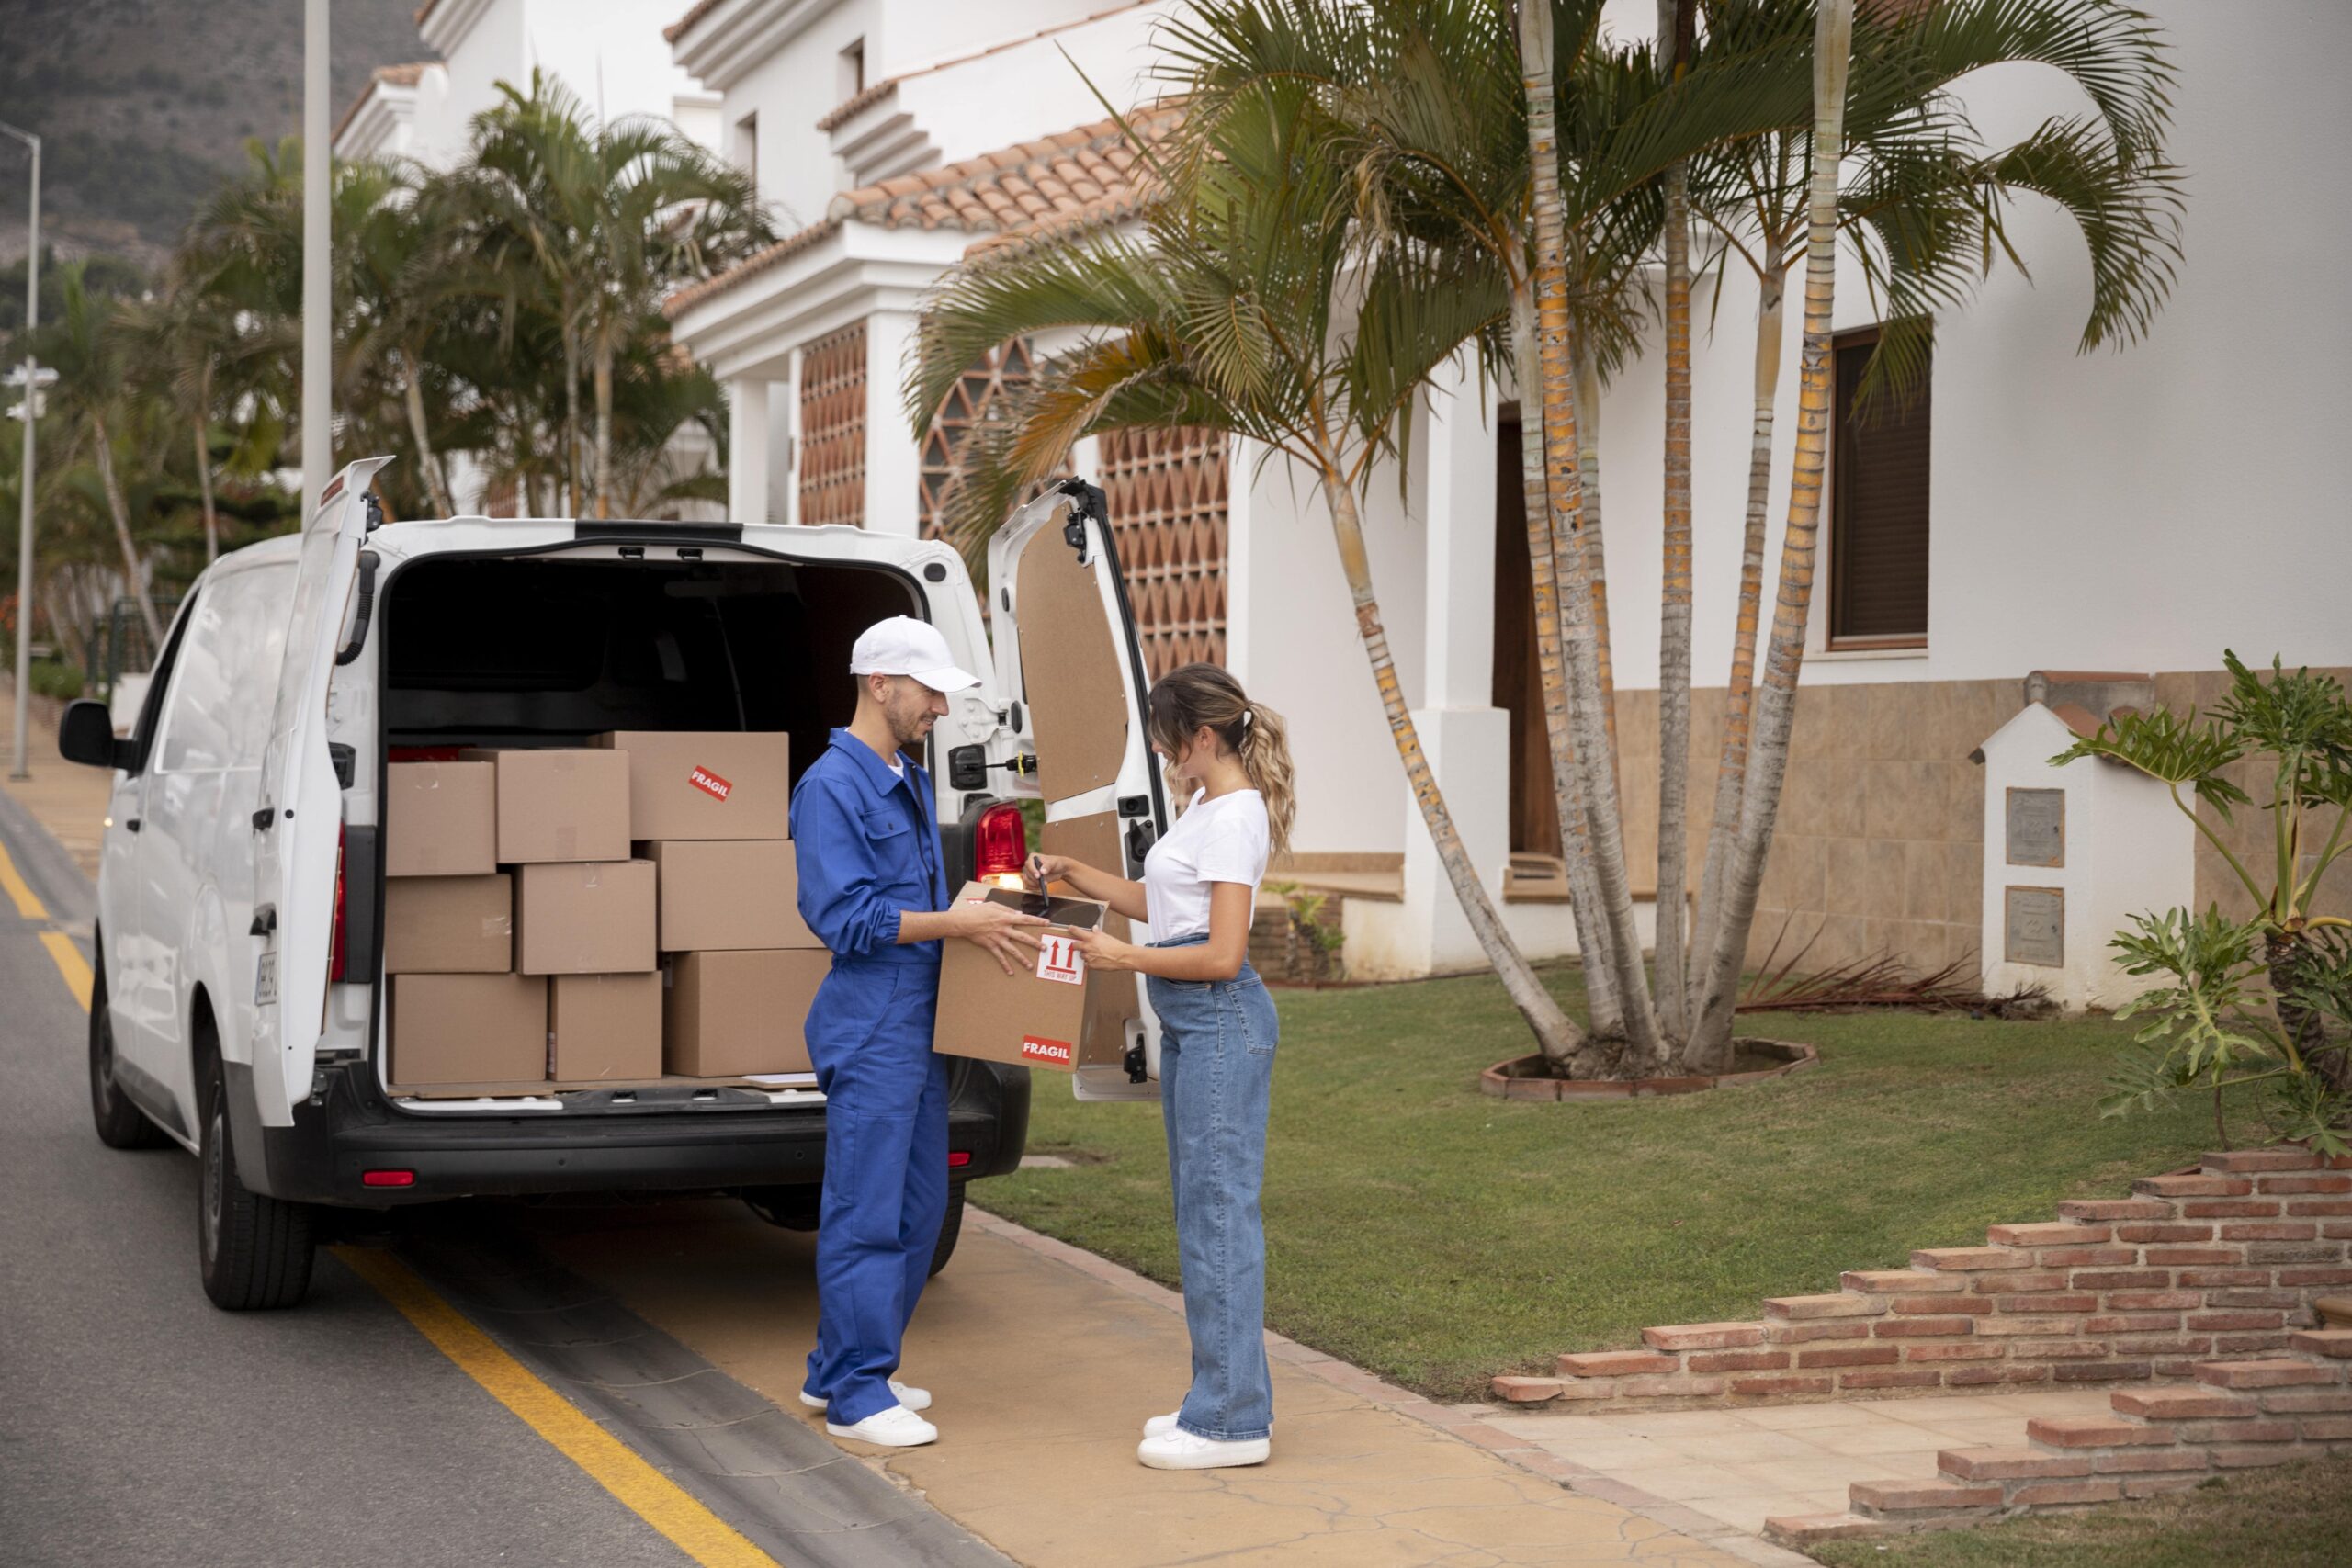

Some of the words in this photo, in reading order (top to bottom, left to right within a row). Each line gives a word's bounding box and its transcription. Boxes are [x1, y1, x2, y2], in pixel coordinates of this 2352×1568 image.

[692, 771, 729, 797] FRAGIL
[1044, 969, 1056, 978] THIS
[1057, 971, 1068, 980] WAY
[1023, 1042, 1069, 1059] FRAGIL
